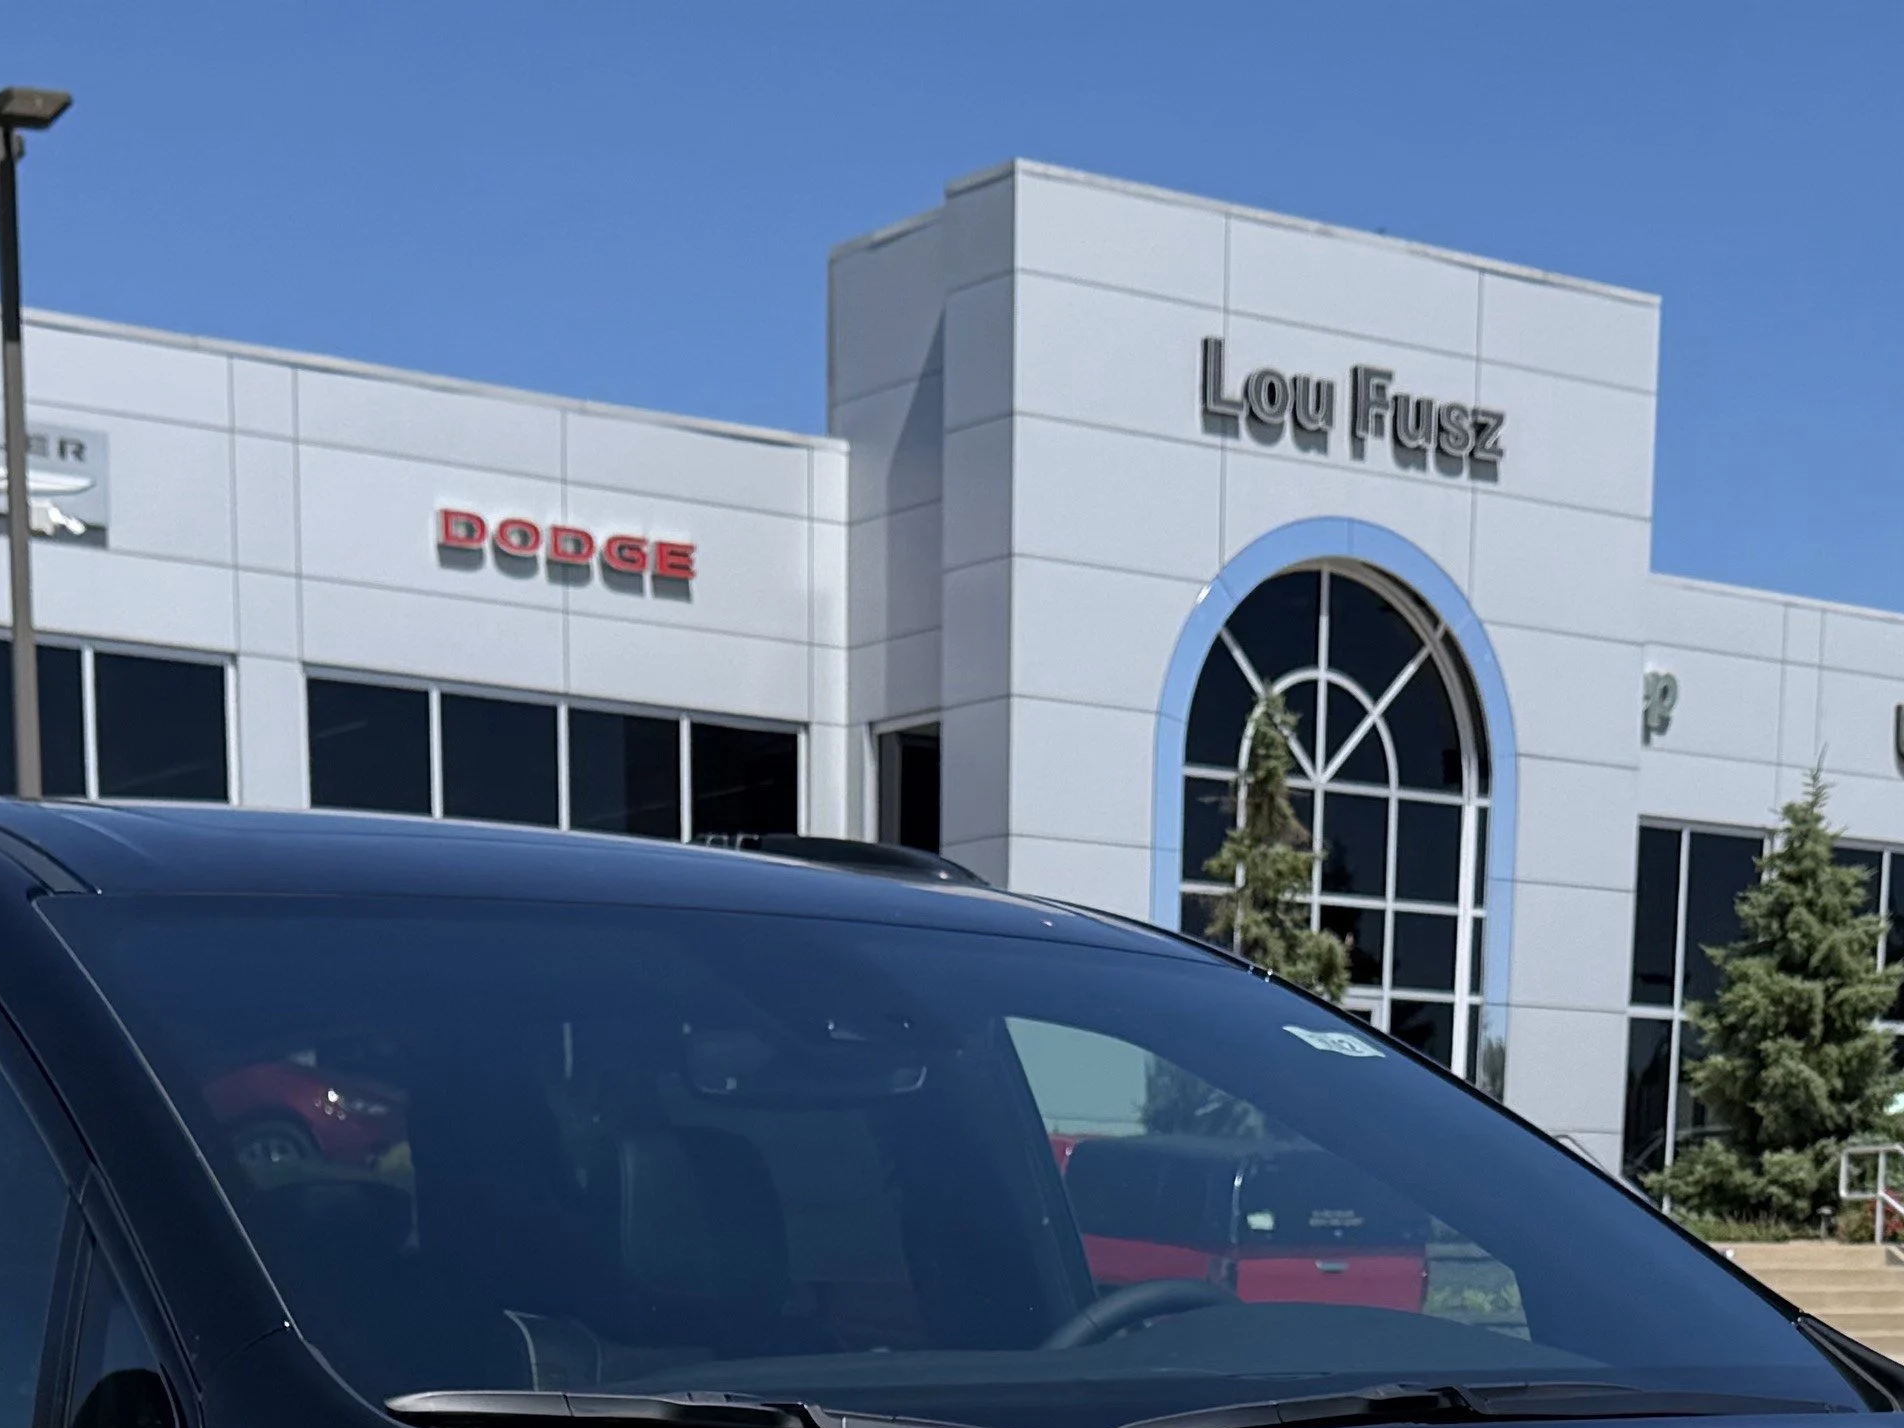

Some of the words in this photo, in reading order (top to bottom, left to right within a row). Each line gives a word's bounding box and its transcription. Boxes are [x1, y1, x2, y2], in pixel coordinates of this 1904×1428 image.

[1200, 336, 1335, 431] Lou
[1350, 364, 1505, 463] Fusz
[438, 508, 696, 580] DODGE
